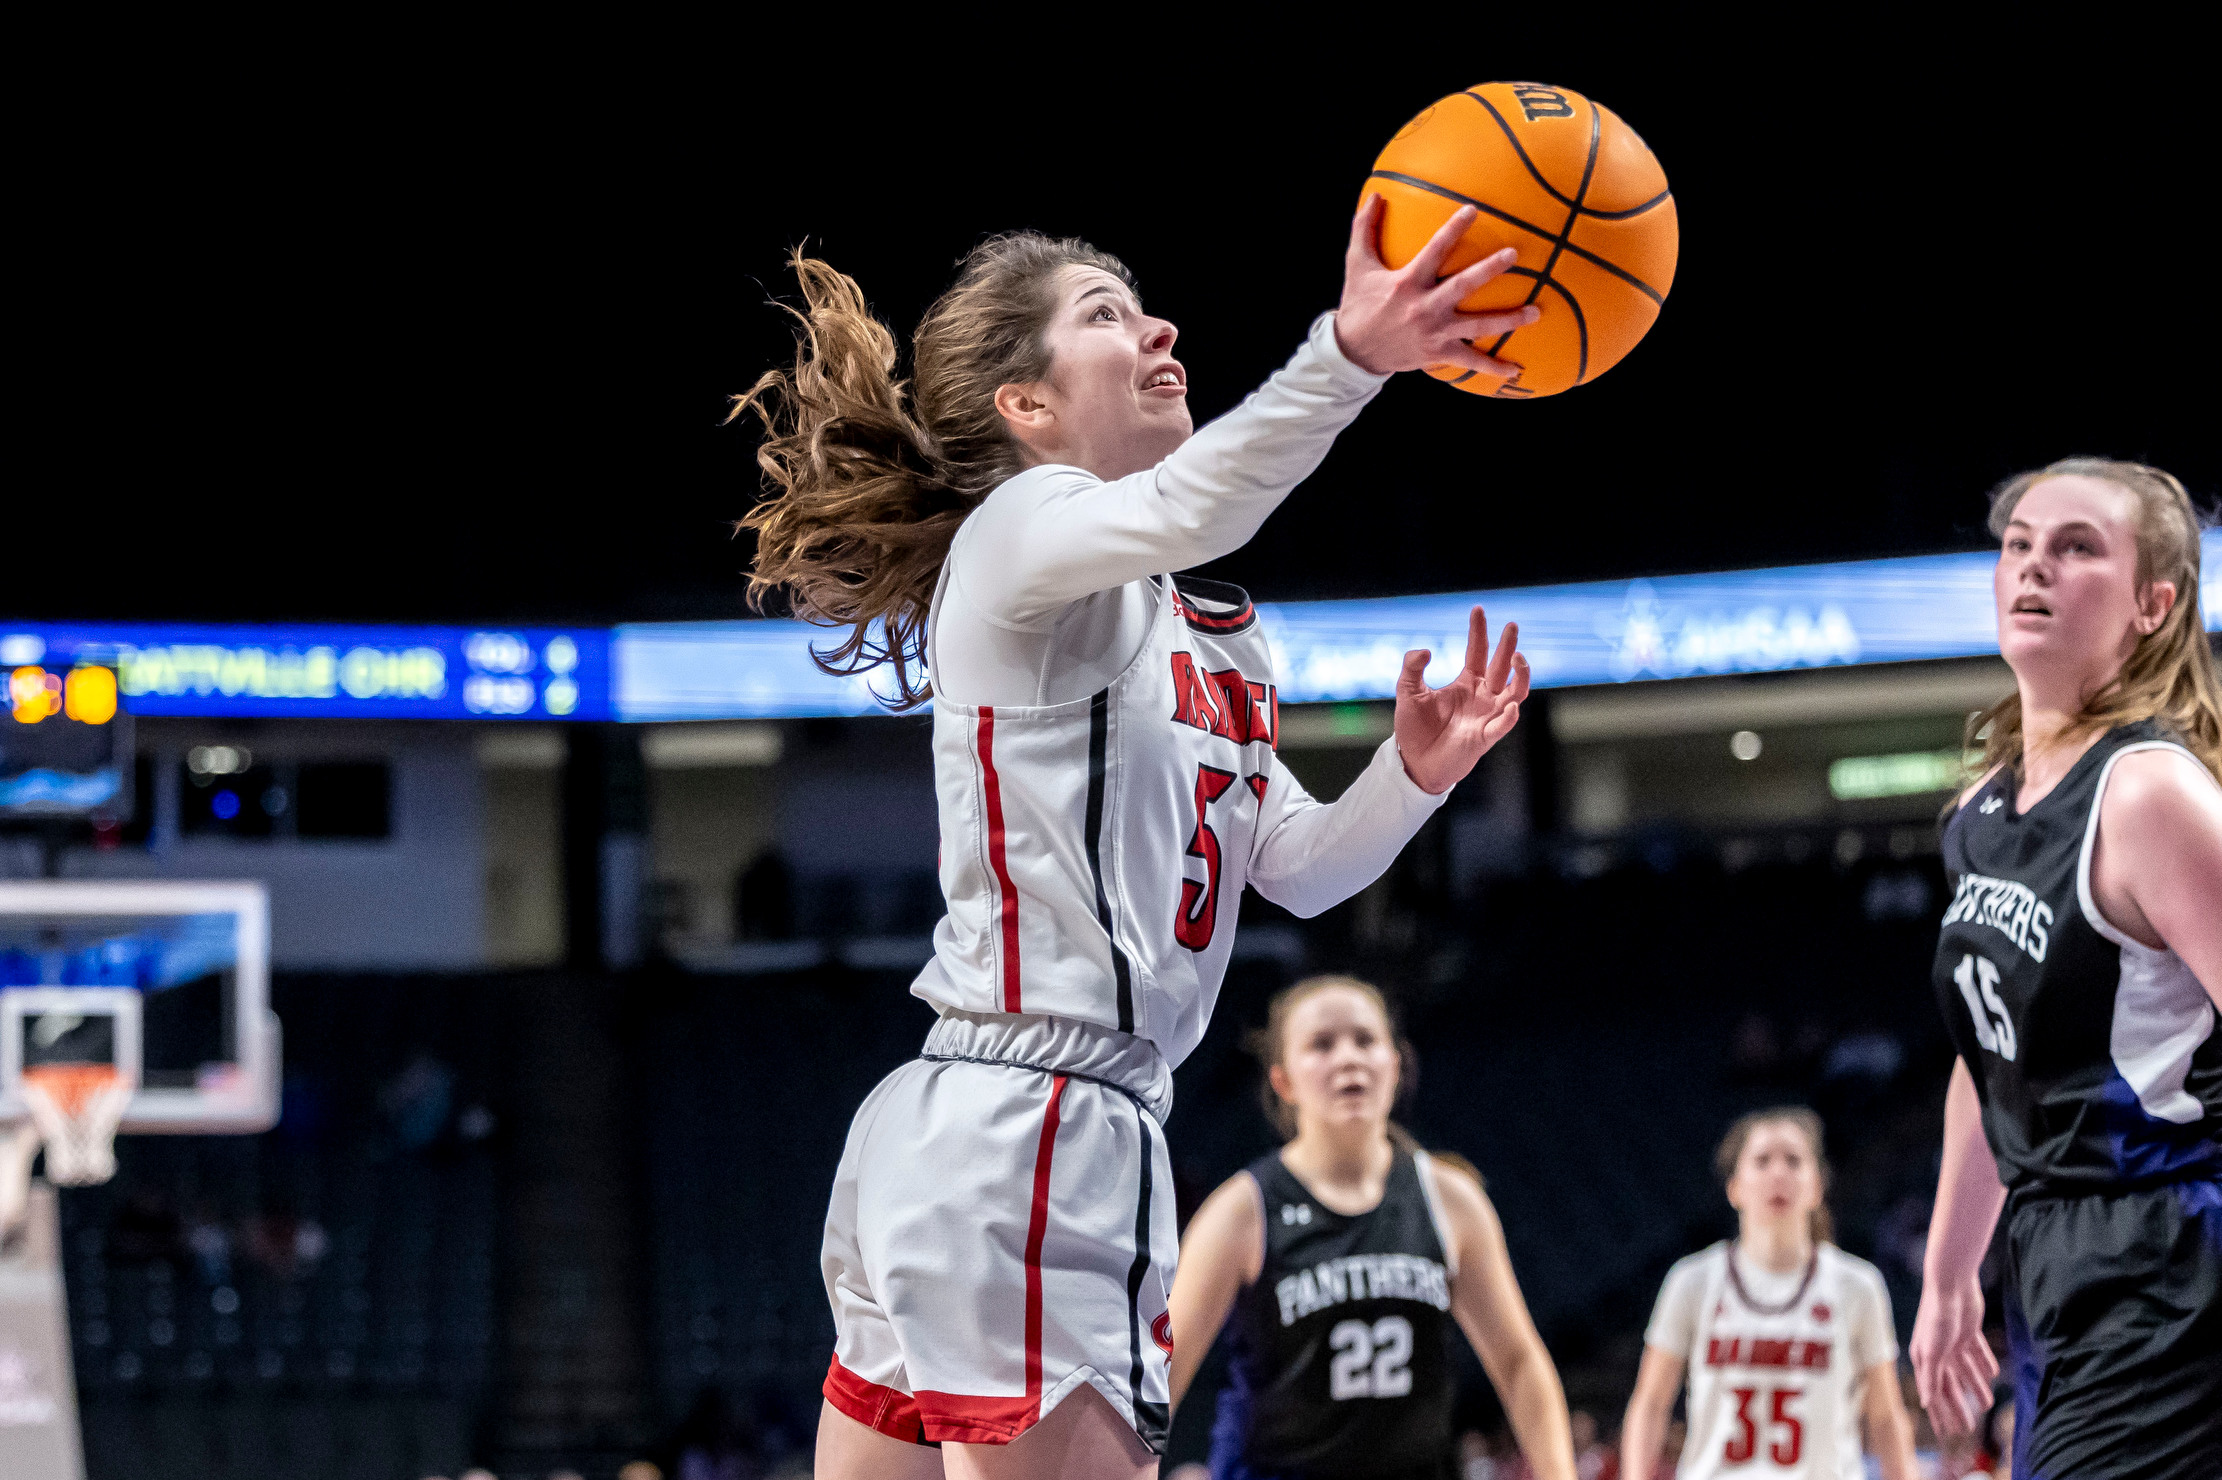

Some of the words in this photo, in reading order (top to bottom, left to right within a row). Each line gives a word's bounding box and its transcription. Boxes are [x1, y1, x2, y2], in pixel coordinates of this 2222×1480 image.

[1953, 953, 2018, 1062] 15
[1275, 1253, 1451, 1327] PANTHERS
[1329, 1315, 1414, 1401] 22
[1723, 1386, 1804, 1467] 35
